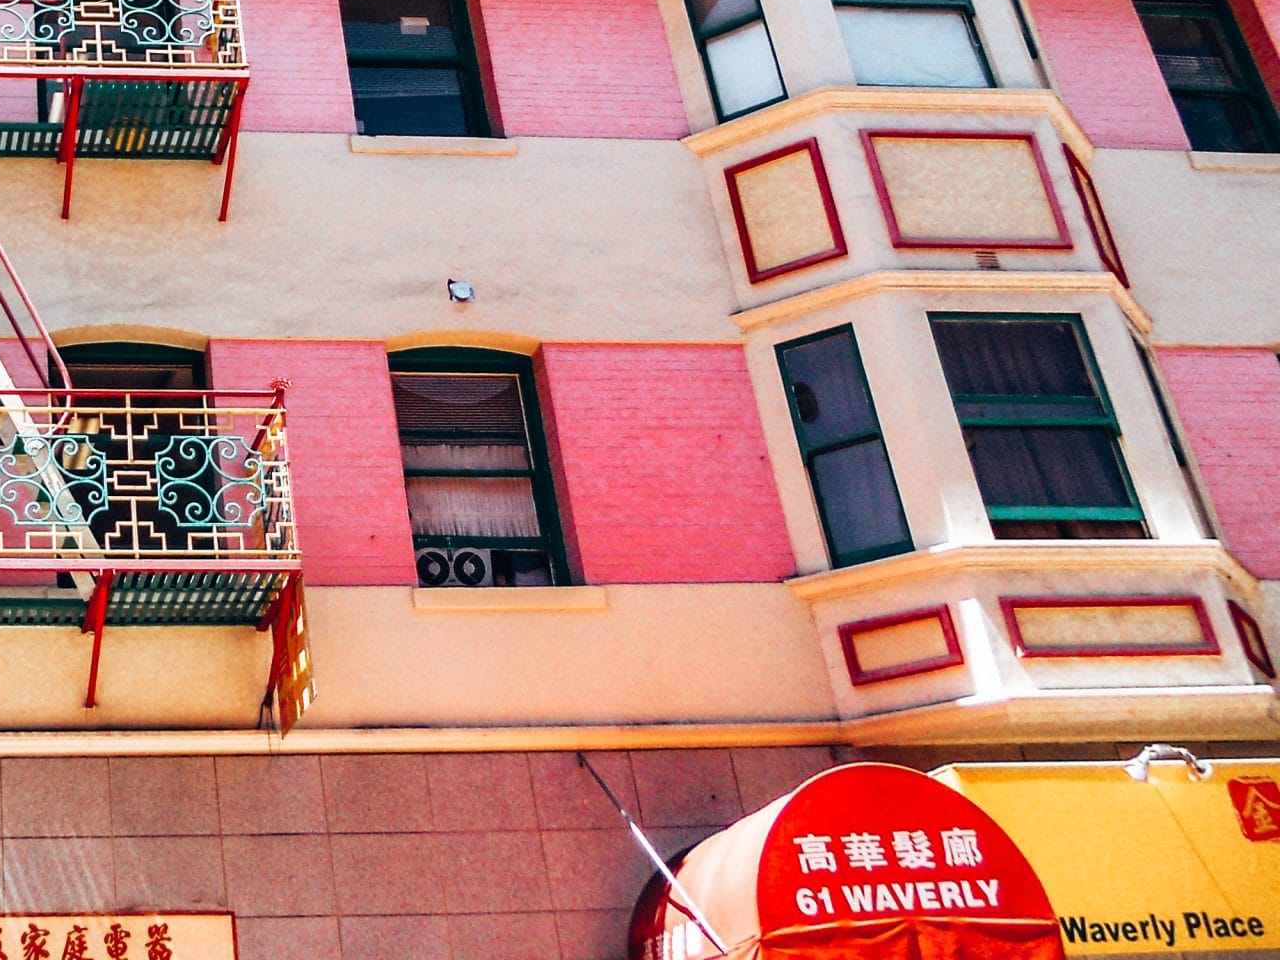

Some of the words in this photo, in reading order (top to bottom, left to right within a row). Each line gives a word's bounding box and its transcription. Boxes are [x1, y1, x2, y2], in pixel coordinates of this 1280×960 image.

[793, 827, 983, 874] 高華髮廊
[796, 887, 835, 916] 61
[841, 879, 1000, 913] WAVERLY
[1060, 914, 1176, 947] Waverly
[1183, 911, 1265, 939] Place
